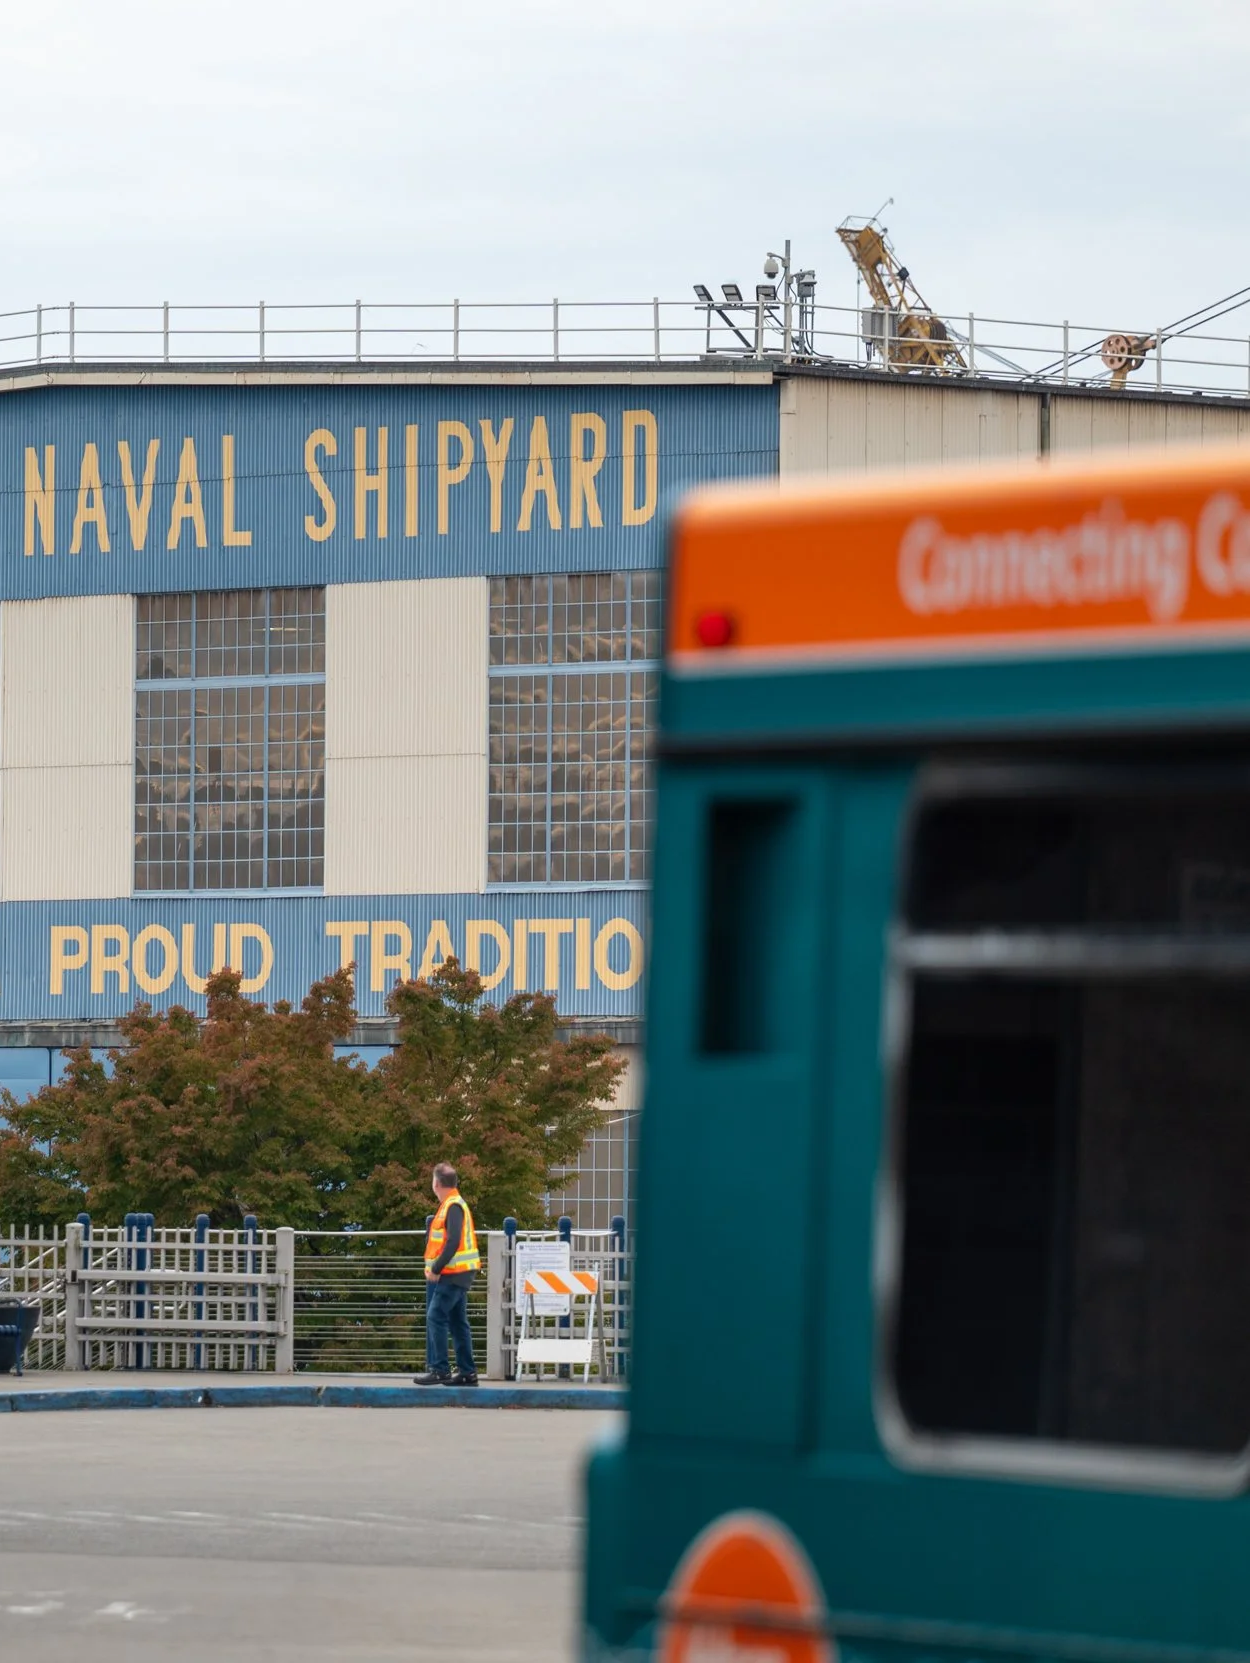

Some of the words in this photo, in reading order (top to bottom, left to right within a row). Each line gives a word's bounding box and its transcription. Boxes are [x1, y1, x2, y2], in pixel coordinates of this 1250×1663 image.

[24, 434, 252, 557] NAVAL
[304, 408, 658, 542] SHIPYARD
[897, 499, 1191, 622] Connecting
[49, 922, 274, 995] PROUD
